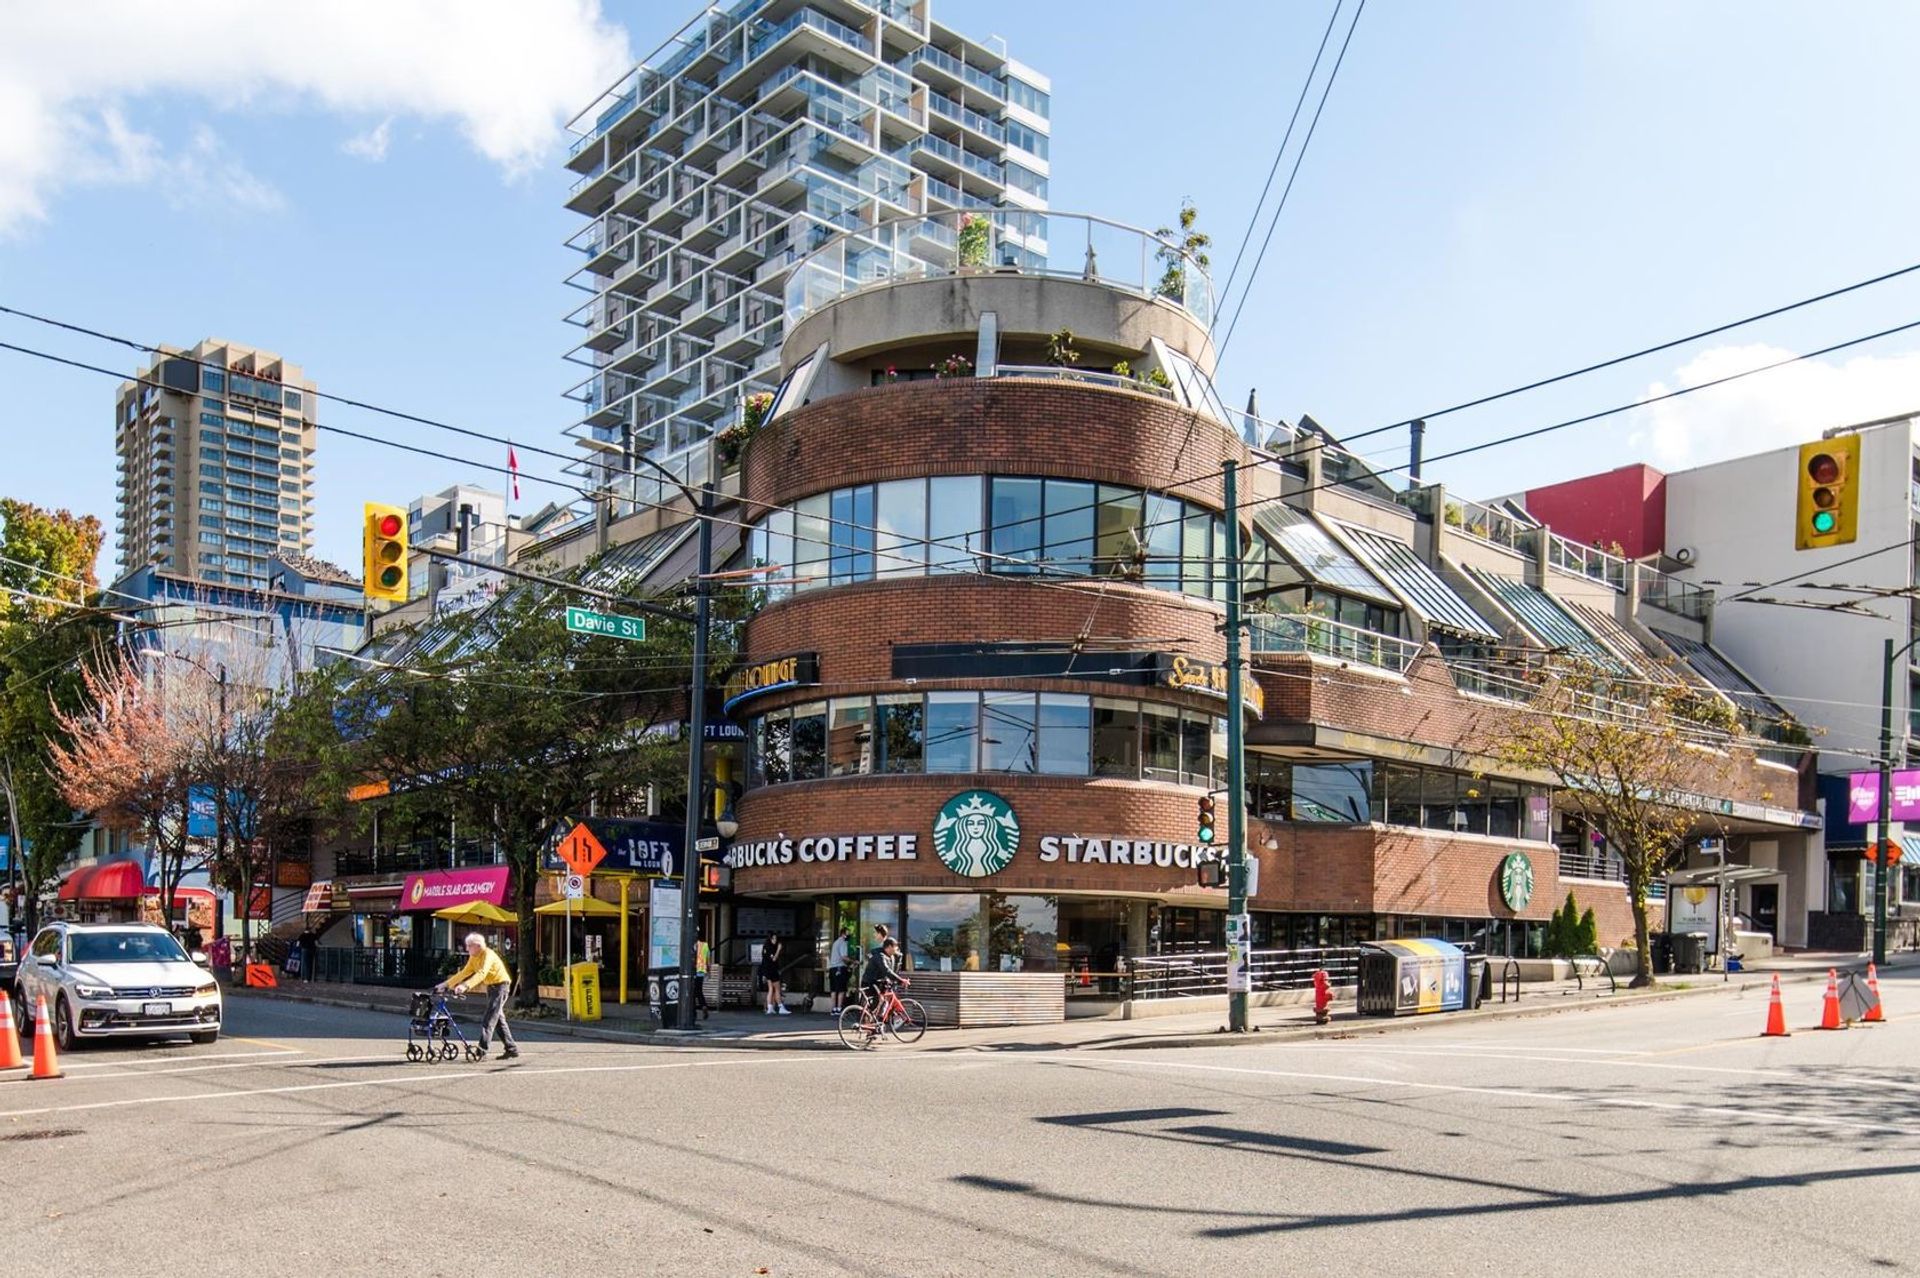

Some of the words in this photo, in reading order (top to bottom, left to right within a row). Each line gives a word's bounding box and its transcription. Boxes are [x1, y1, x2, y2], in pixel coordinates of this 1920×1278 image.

[574, 612, 615, 633] Davie
[621, 619, 638, 636] St
[704, 725, 716, 736] FT
[628, 839, 670, 867] LOFT
[728, 837, 794, 869] RBUCKS
[799, 835, 917, 863] COFFEE
[423, 885, 447, 897] MARBLE
[446, 883, 461, 896] SLAB
[461, 881, 496, 896] CREAMERY
